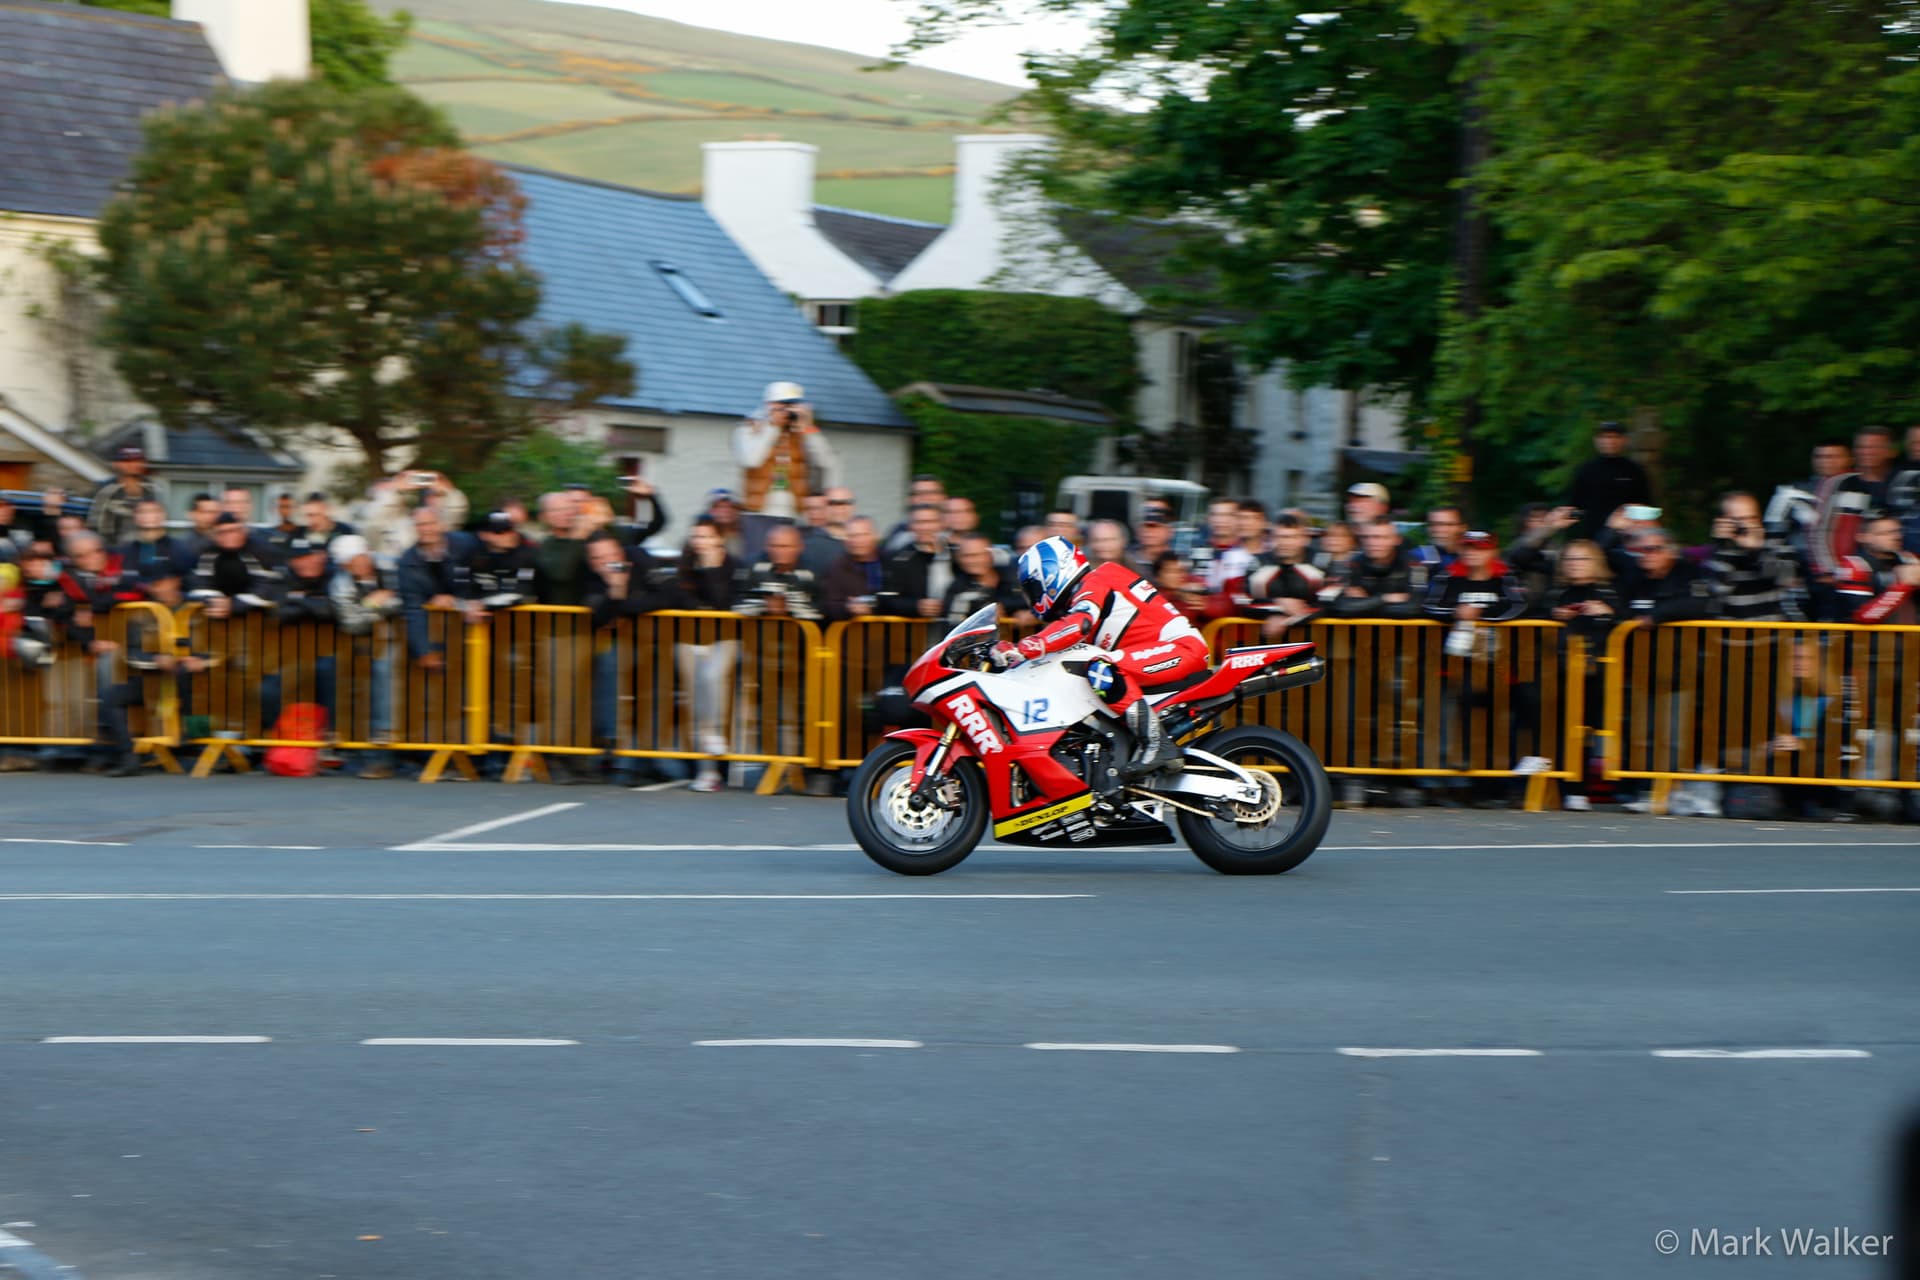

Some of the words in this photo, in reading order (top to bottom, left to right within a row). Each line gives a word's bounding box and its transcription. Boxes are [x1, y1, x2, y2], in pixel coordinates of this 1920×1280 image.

[1231, 653, 1268, 669] RRR
[1024, 698, 1049, 724] 12
[946, 694, 1003, 755] RRR
[1019, 806, 1069, 826] DUNLOP
